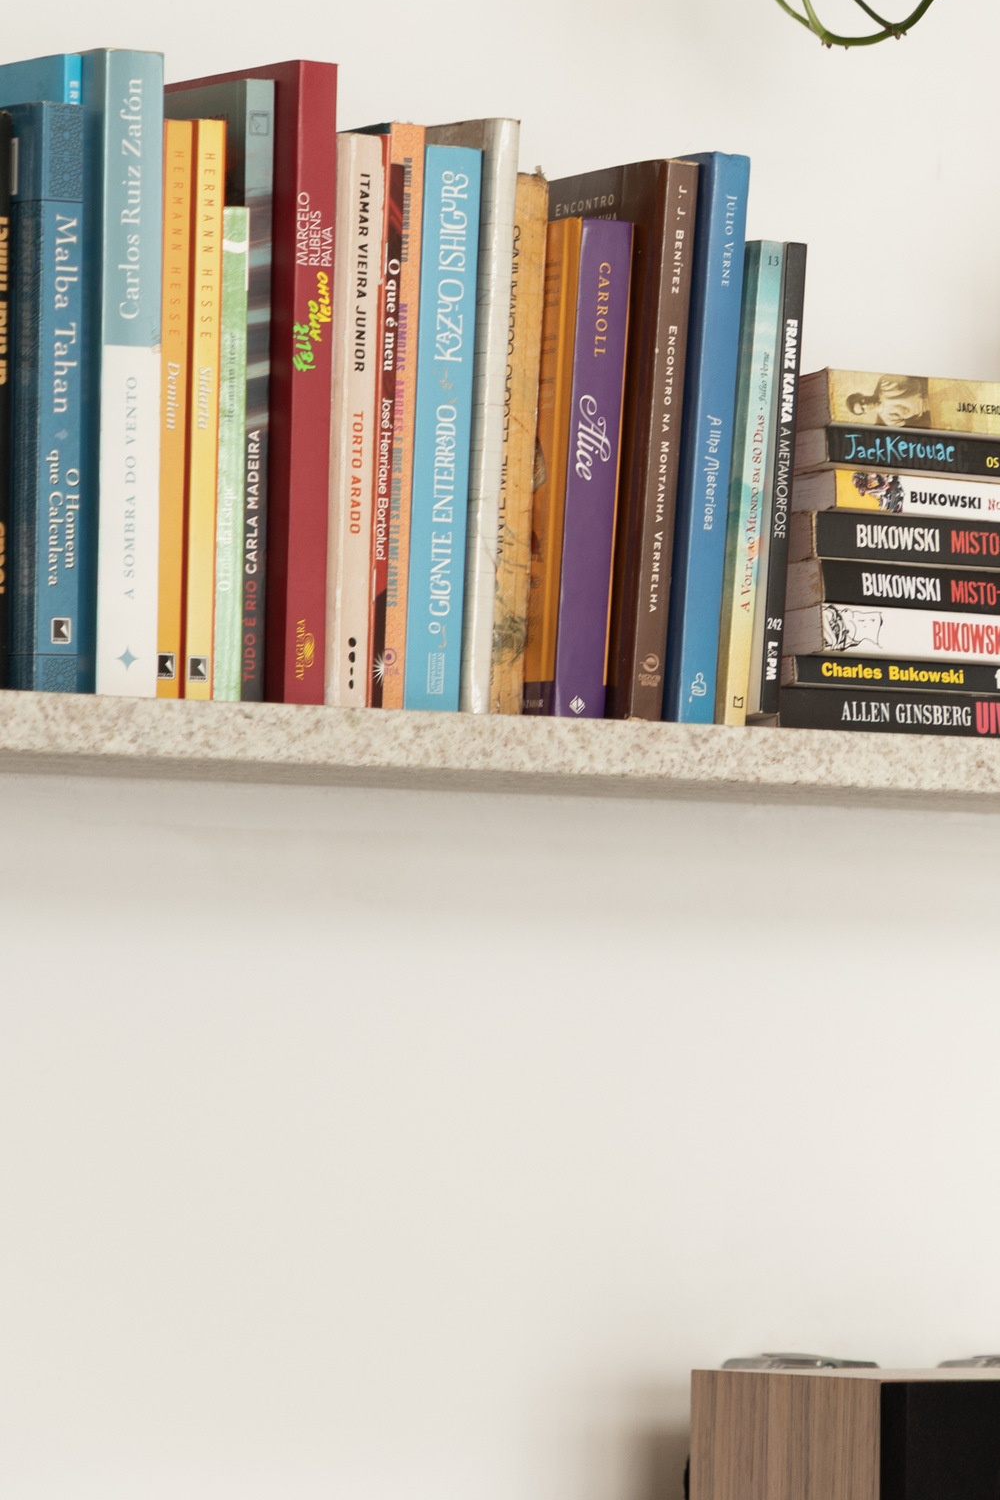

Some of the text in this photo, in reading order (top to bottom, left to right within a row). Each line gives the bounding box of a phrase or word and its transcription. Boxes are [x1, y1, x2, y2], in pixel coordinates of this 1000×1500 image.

[118, 78, 143, 320] Carlos Ruiz Zafón
[296, 191, 310, 266] MARCELO
[308, 210, 322, 266] RUBENS
[555, 193, 616, 217] ENCONTRO
[168, 151, 184, 336] HERMANN HESSE
[200, 152, 215, 338] HERMANN HESSE
[320, 226, 333, 267] PAIVA
[354, 173, 370, 373] ITAMAR VIEIRA JUNIOR
[767, 255, 780, 267] 13
[53, 214, 79, 413] Malba Tahan
[593, 262, 612, 357] CARROLL
[166, 361, 180, 431] Demian
[197, 365, 212, 430] Sidarta
[702, 194, 738, 531] JÚLIO VERNE Misteriosa
[576, 394, 613, 482] Alice
[648, 229, 685, 614] BENÍTEZ ENCONTRO NA MONTANHA VERMELHA
[773, 318, 799, 539] FRANZ KAFKA METAMORFOSE
[956, 402, 978, 414] JACK
[123, 376, 138, 581] SOMBRA DO VENTO
[349, 410, 364, 535] TORTO ARADO
[375, 431, 391, 561] Henrique Bortoluci
[429, 404, 457, 617] GIGANTE ENTERRADO
[910, 491, 982, 510] BUKOWSKI
[45, 449, 64, 586] que Calculava
[63, 494, 80, 570] Homem
[243, 428, 260, 682] TUDO CARLA MADEIRA
[856, 523, 940, 553] BUKOWSKI
[767, 617, 783, 631] 242
[861, 572, 941, 602] BUKOWSKI
[765, 640, 779, 681] L&PM
[821, 662, 882, 679] Charles
[889, 665, 964, 684] Bukowski
[841, 701, 890, 723] ALLEN
[895, 703, 972, 726] GINSBERG
